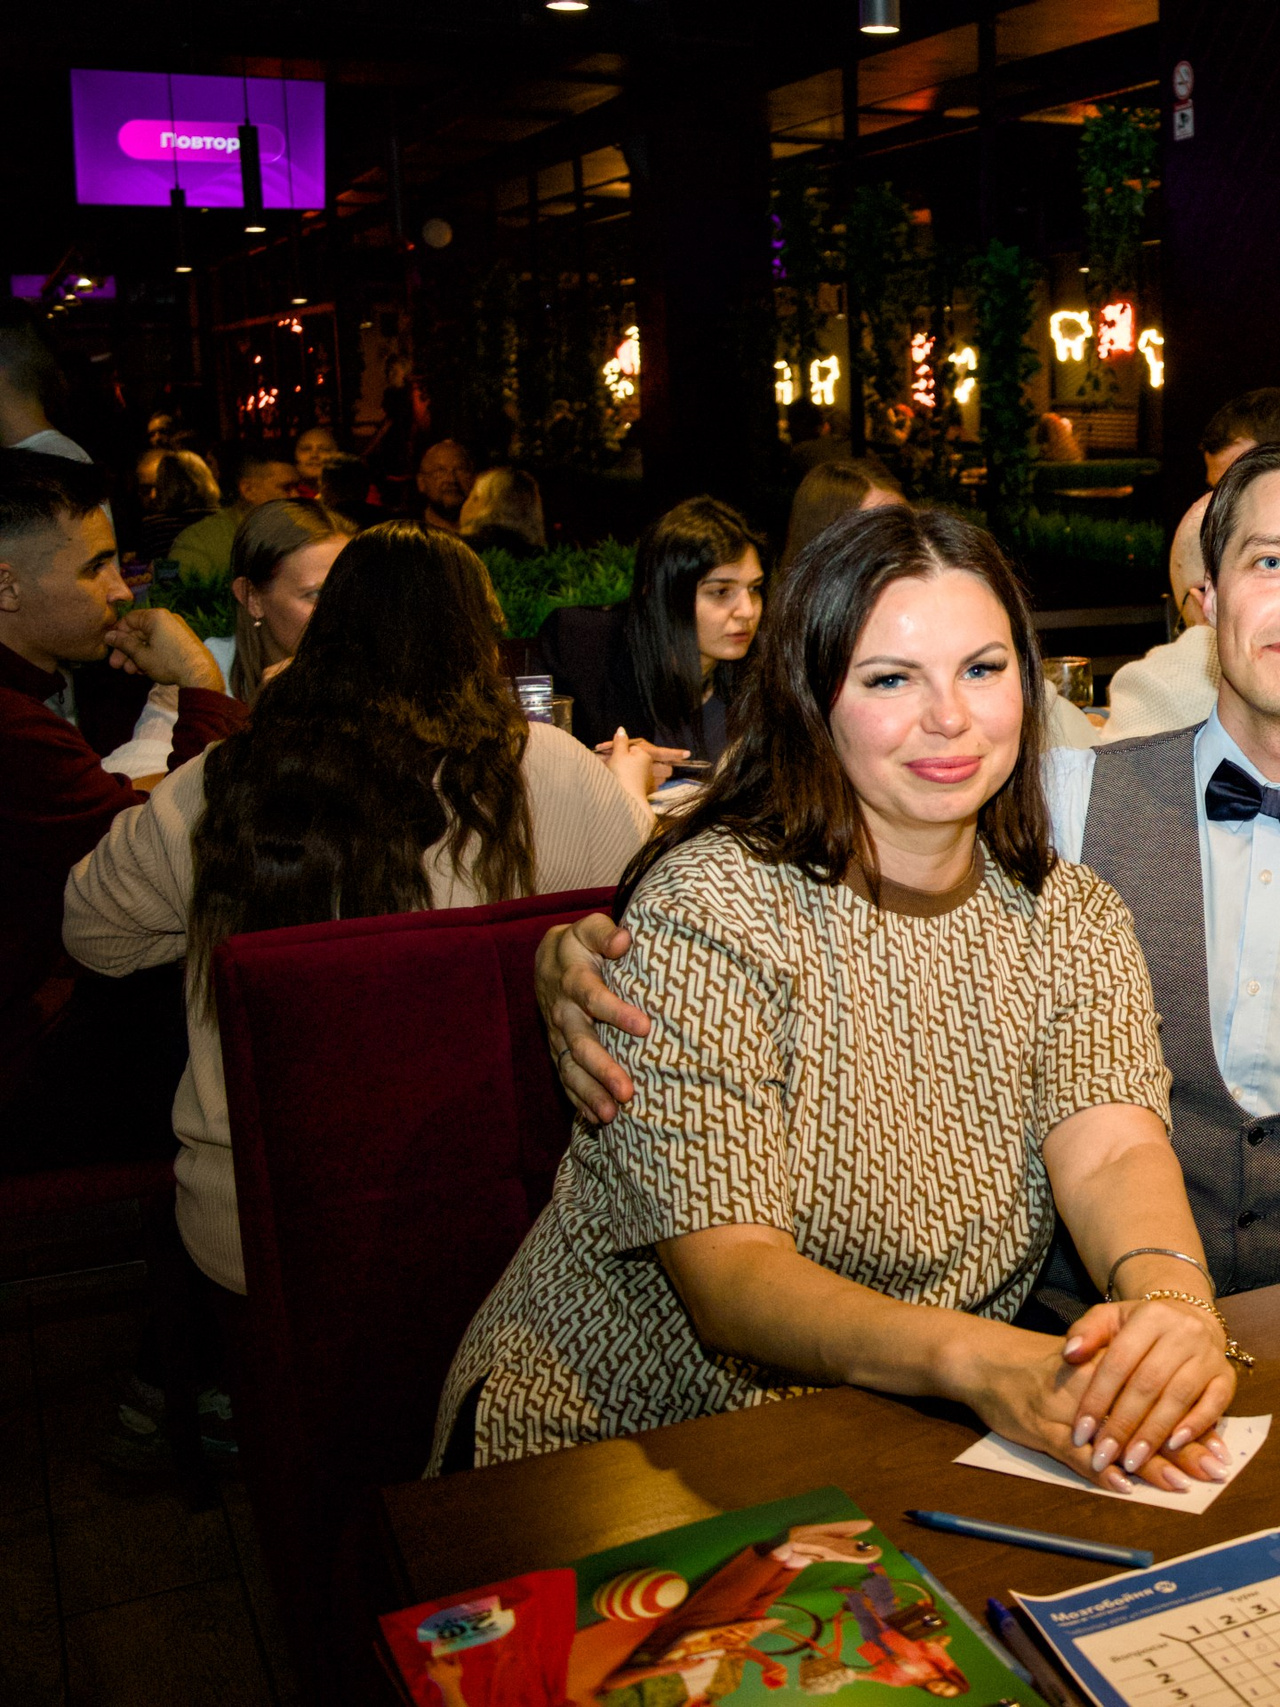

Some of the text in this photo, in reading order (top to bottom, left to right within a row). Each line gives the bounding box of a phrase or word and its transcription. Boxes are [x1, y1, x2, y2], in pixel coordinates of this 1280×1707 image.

[1050, 1587, 1155, 1622] Мозгобойня
[1187, 1624, 1201, 1635] 1
[1219, 1614, 1237, 1625] 2
[1251, 1604, 1267, 1615] 3
[1143, 1658, 1158, 1668] 1
[1155, 1673, 1175, 1684] 2
[1170, 1688, 1189, 1700] 3
